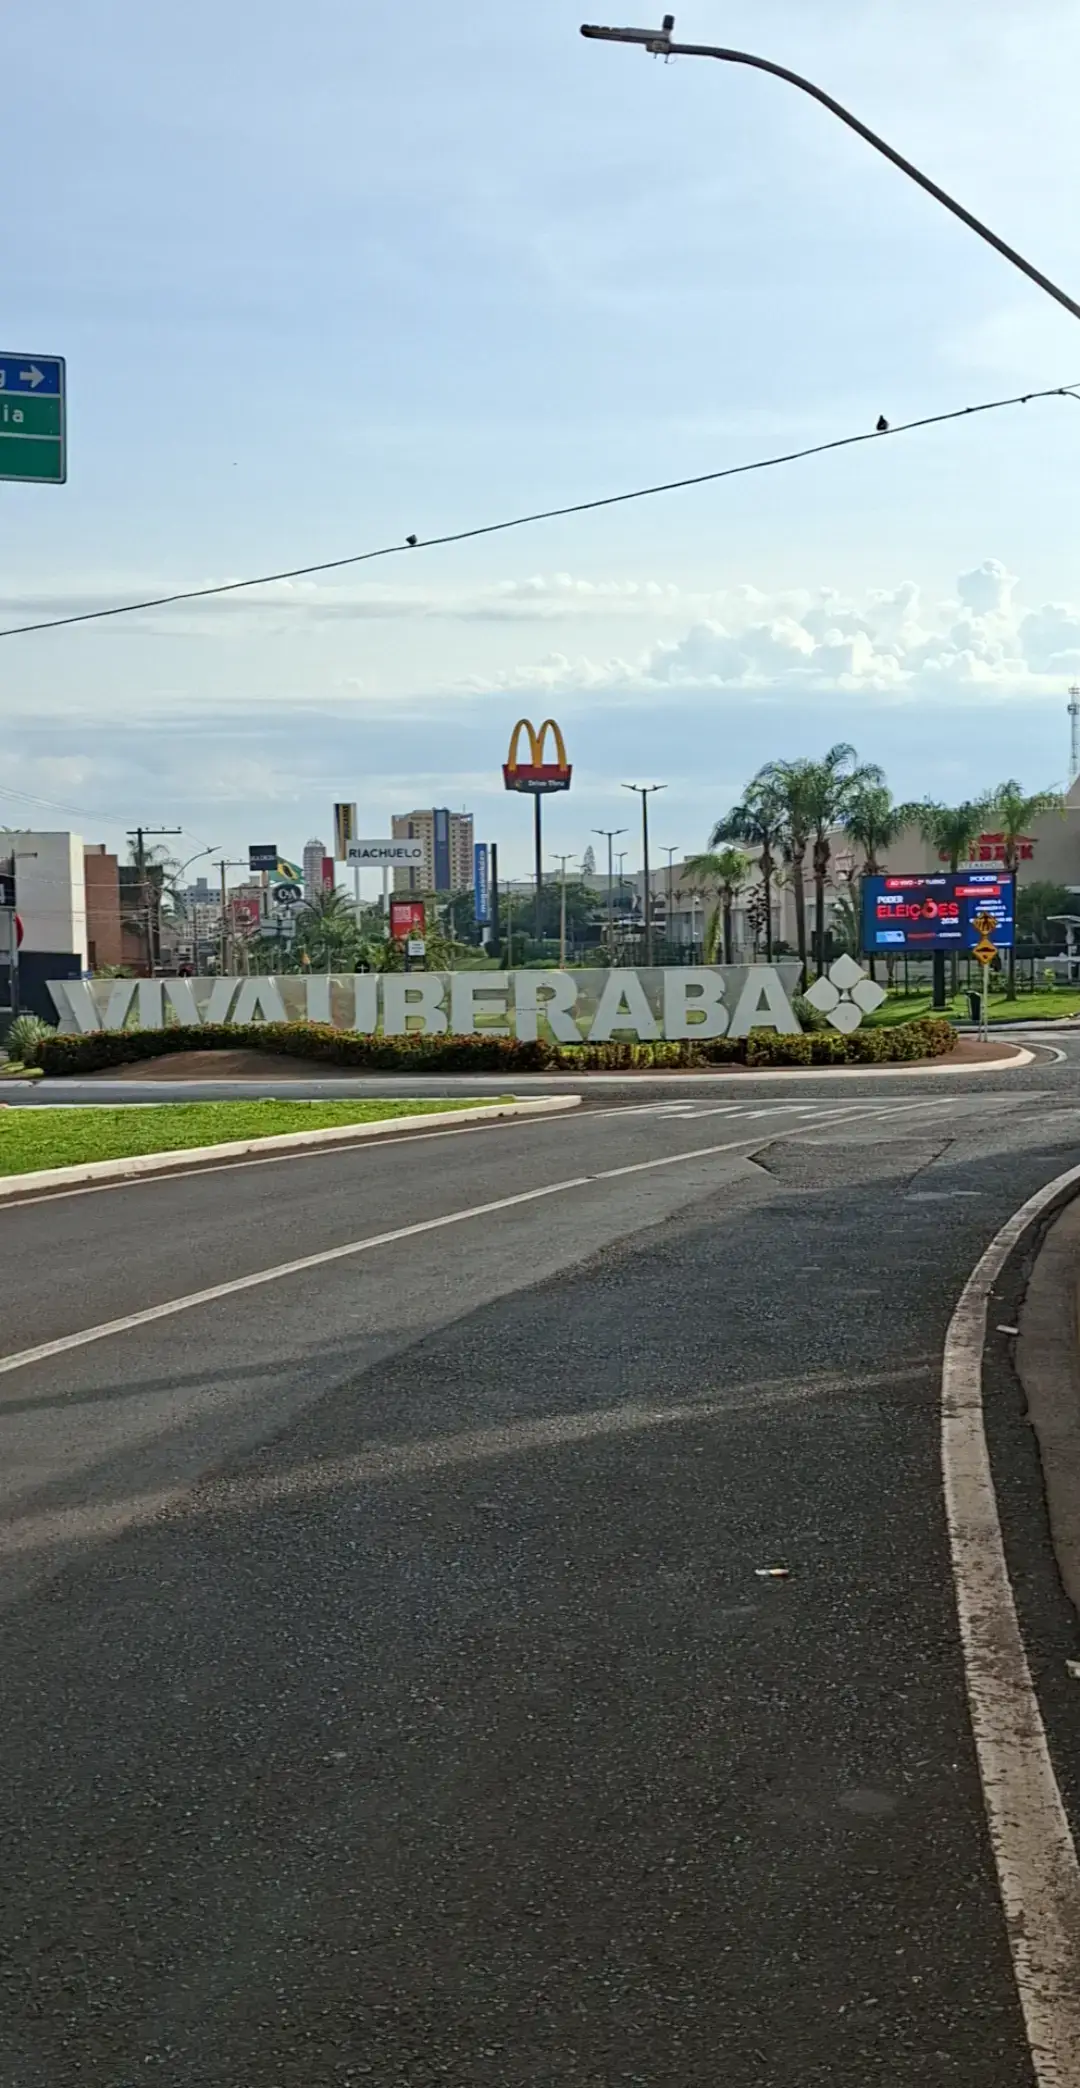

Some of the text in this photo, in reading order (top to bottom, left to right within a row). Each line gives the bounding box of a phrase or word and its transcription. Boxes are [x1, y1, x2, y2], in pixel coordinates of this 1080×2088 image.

[348, 848, 422, 858] RIACHUELO
[877, 895, 903, 904] PODER
[876, 897, 959, 920] ELEIÇÕES
[46, 966, 801, 1042] VIVA UBERABA
